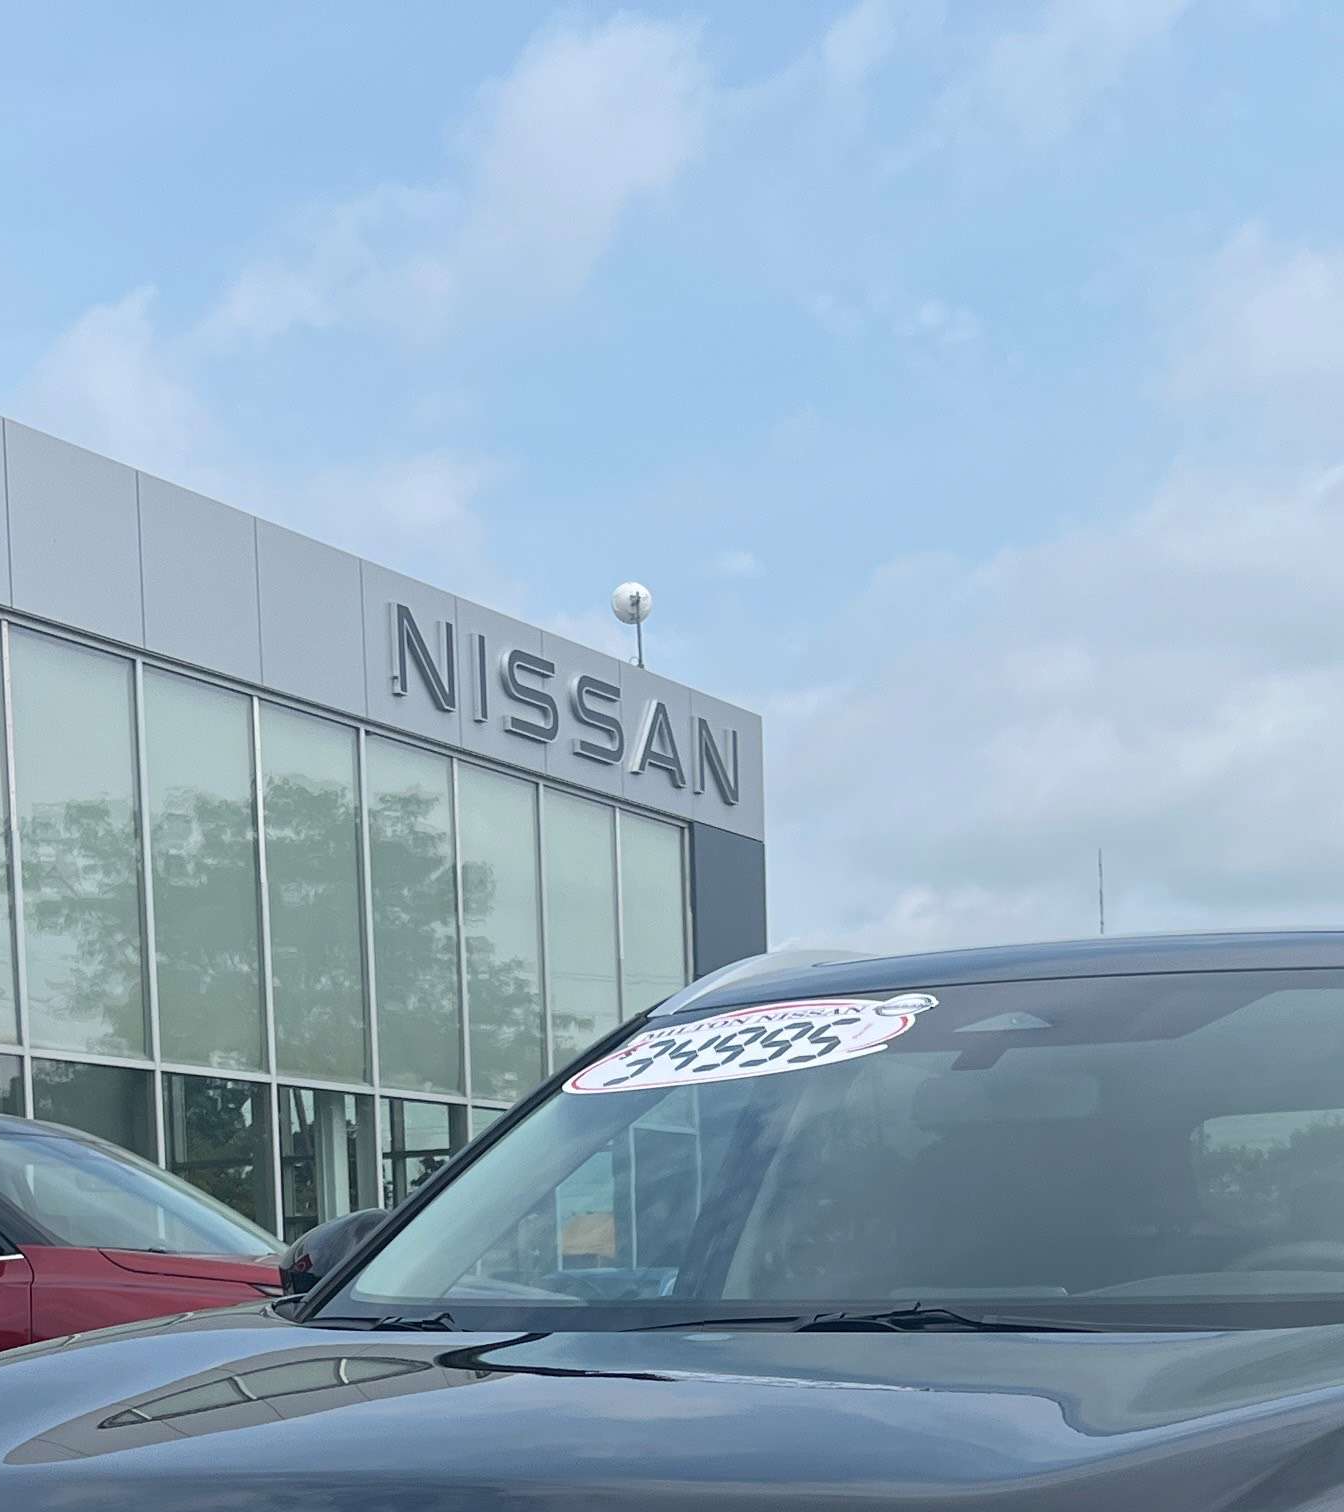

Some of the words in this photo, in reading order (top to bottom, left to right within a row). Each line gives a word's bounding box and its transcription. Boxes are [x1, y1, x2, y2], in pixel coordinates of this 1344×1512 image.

[390, 602, 738, 805] NISSAN
[603, 1018, 861, 1086] 34995
[645, 1017, 752, 1041] MILTON
[757, 1006, 865, 1022] NISSAN
